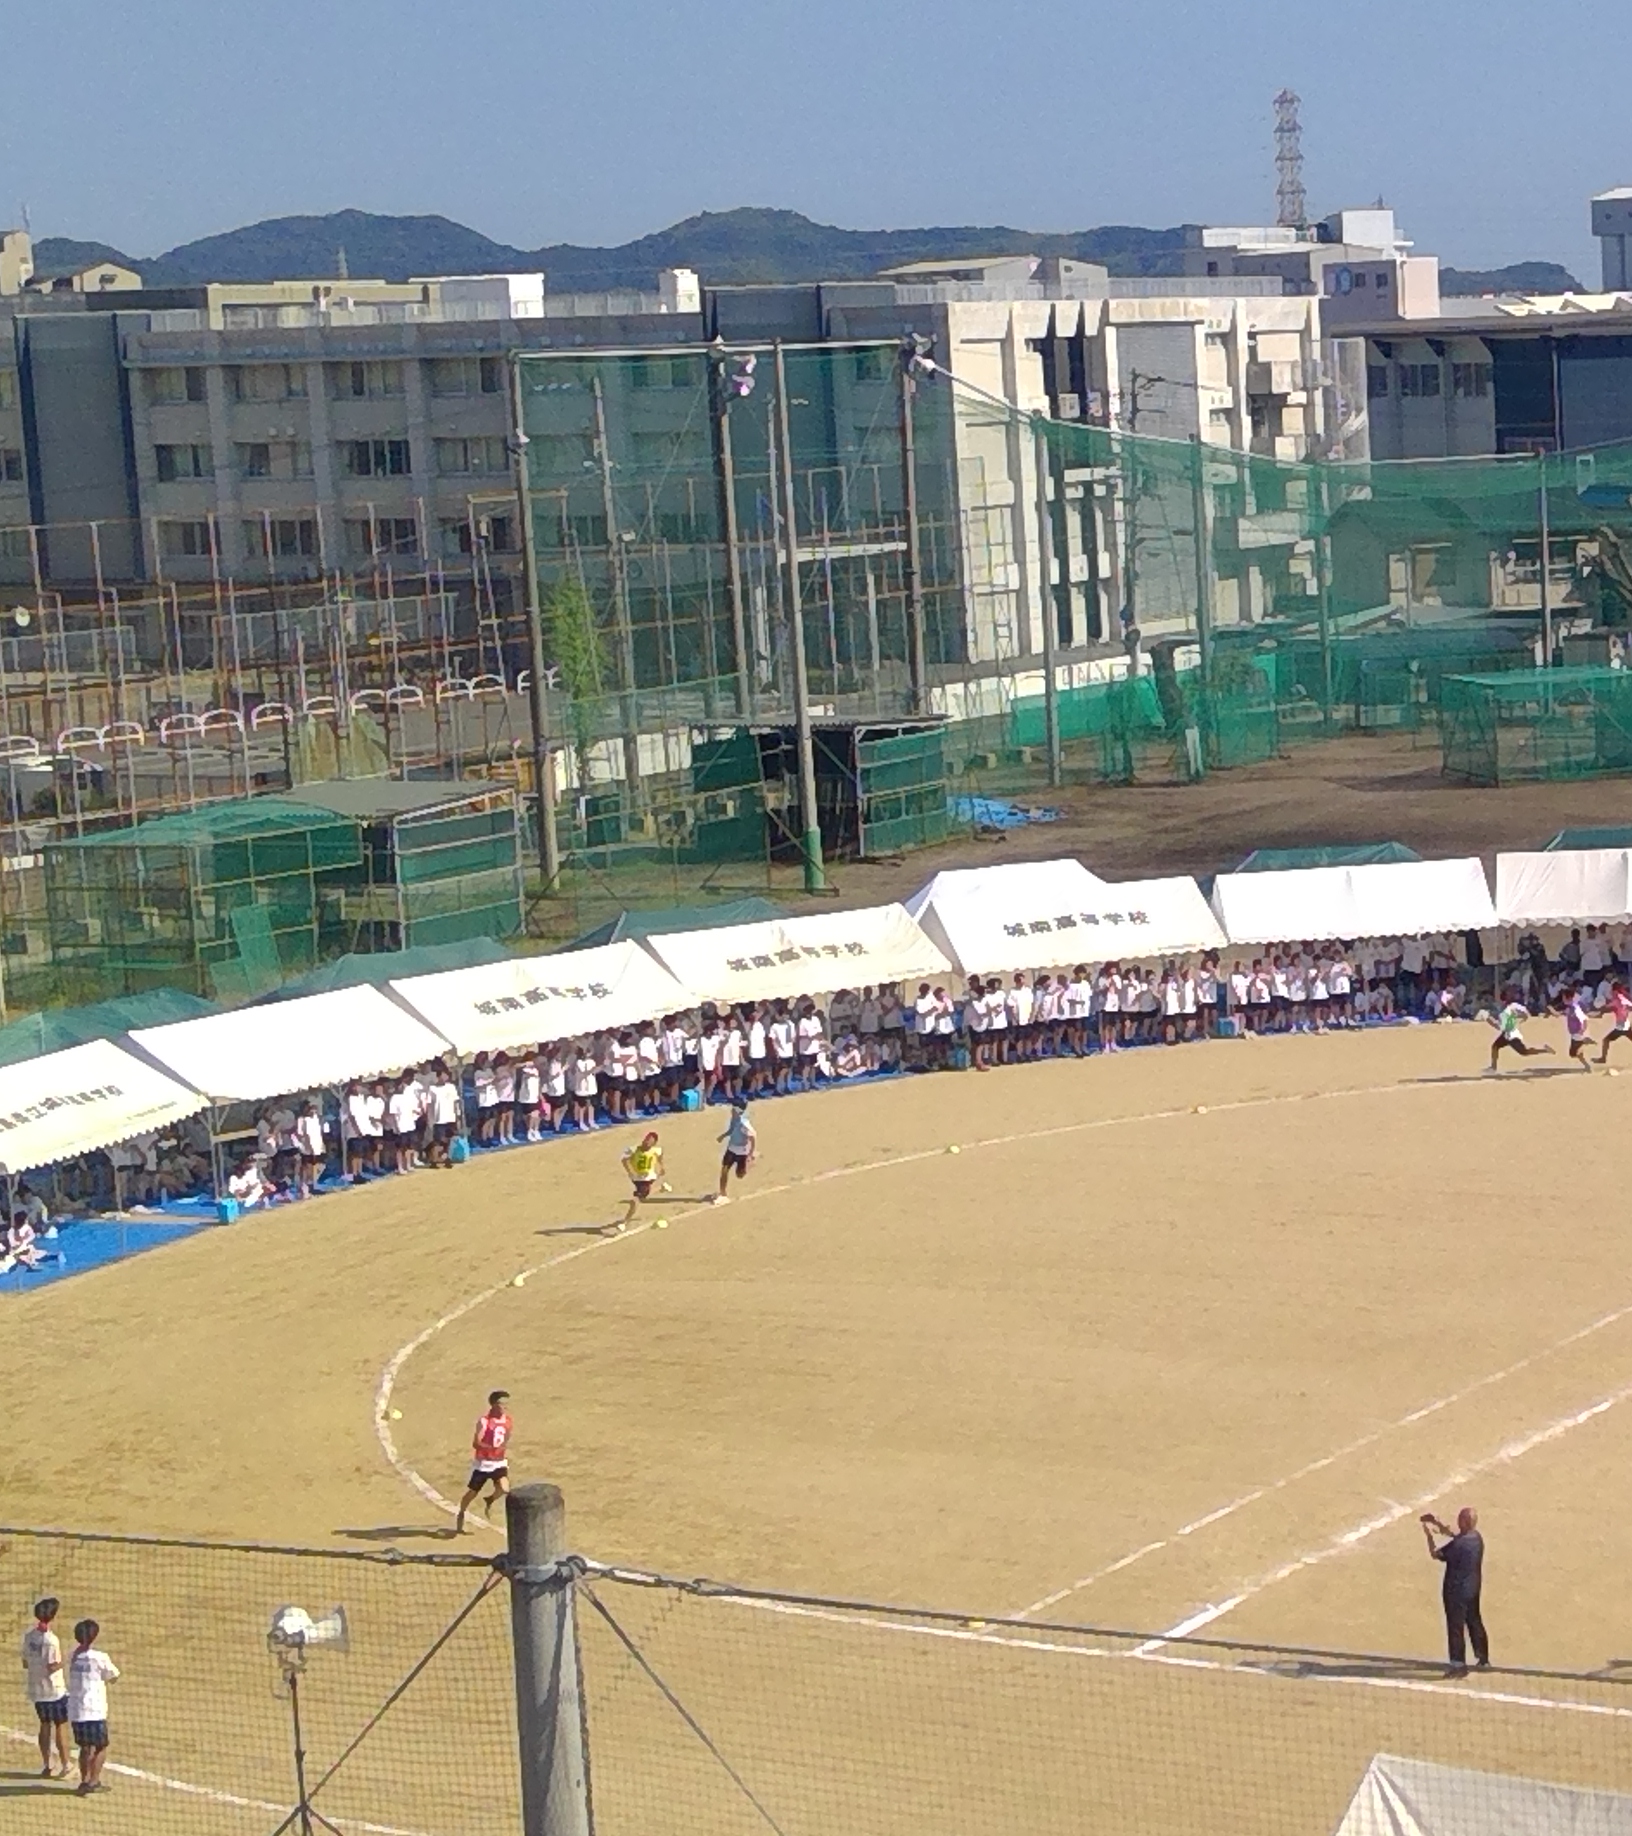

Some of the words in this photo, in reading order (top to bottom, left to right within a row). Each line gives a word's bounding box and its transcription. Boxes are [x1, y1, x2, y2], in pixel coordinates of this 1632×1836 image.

[1003, 911, 1151, 937] 城南高等学校
